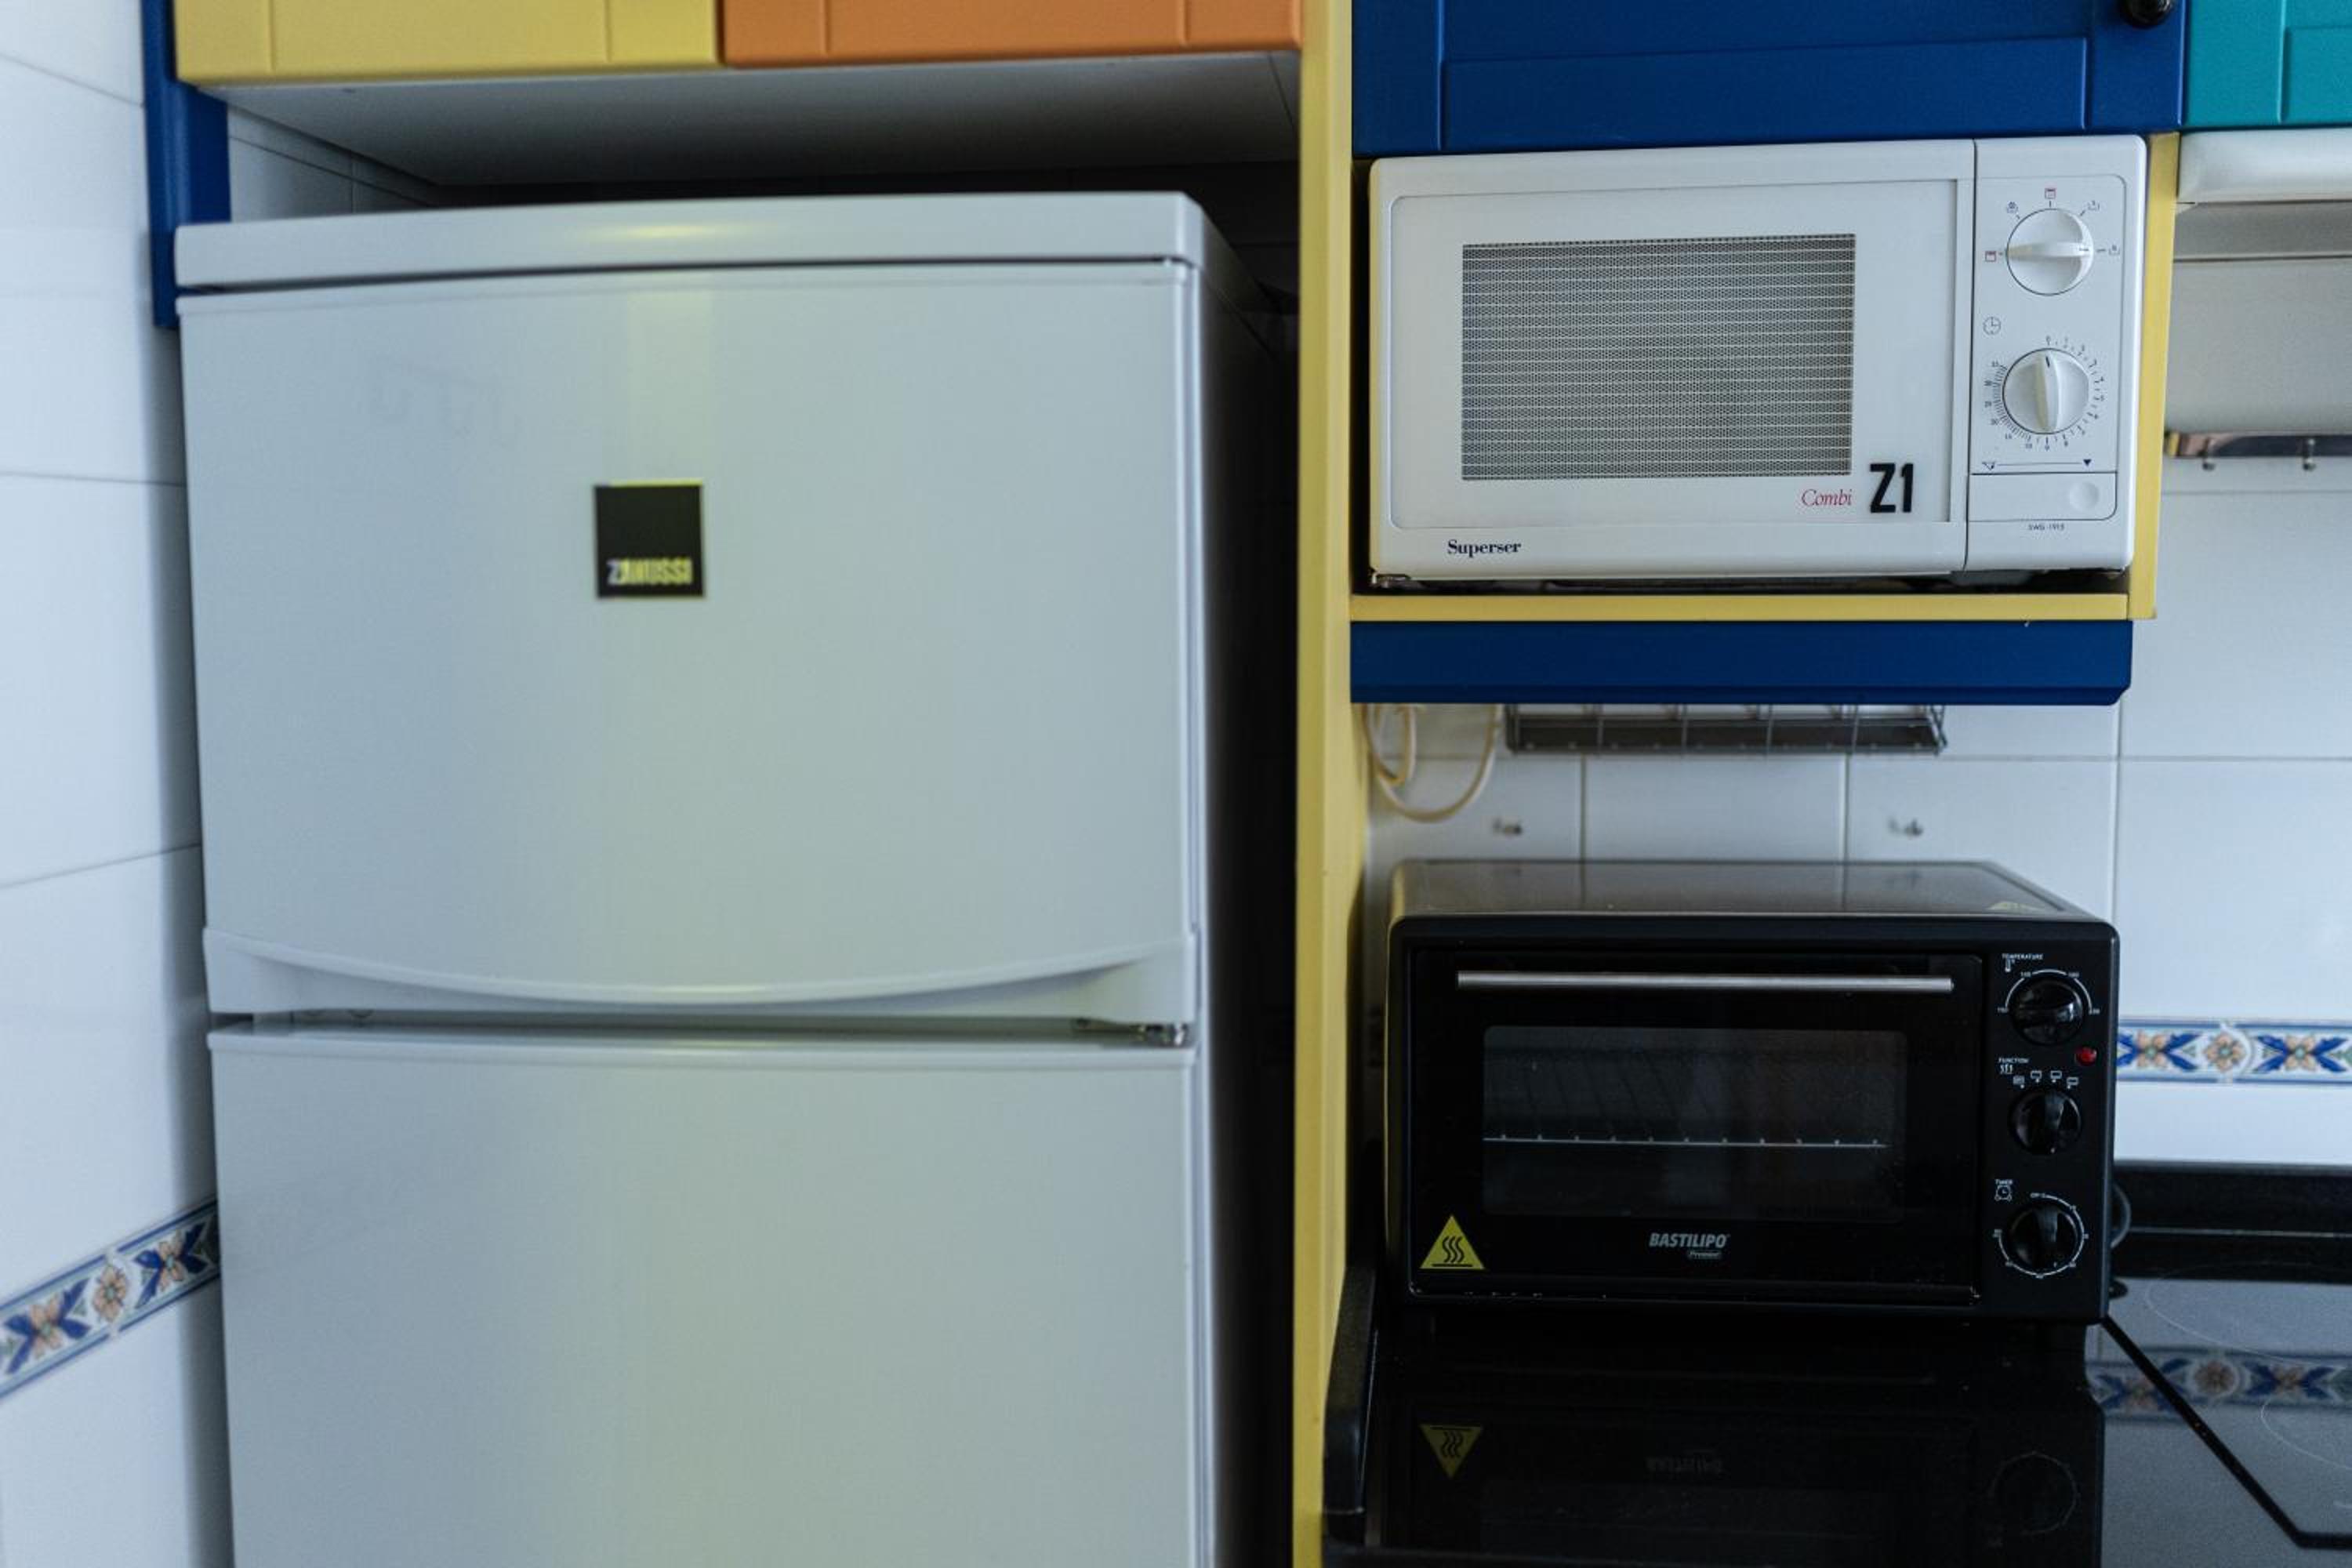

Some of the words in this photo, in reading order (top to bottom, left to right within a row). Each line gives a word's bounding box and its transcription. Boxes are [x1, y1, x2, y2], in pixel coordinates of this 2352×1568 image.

[1801, 488, 1853, 507] Combi
[1870, 463, 1915, 514] Z1
[1447, 539, 1523, 558] Superser
[1648, 1232, 1728, 1248] BASTILIPO
